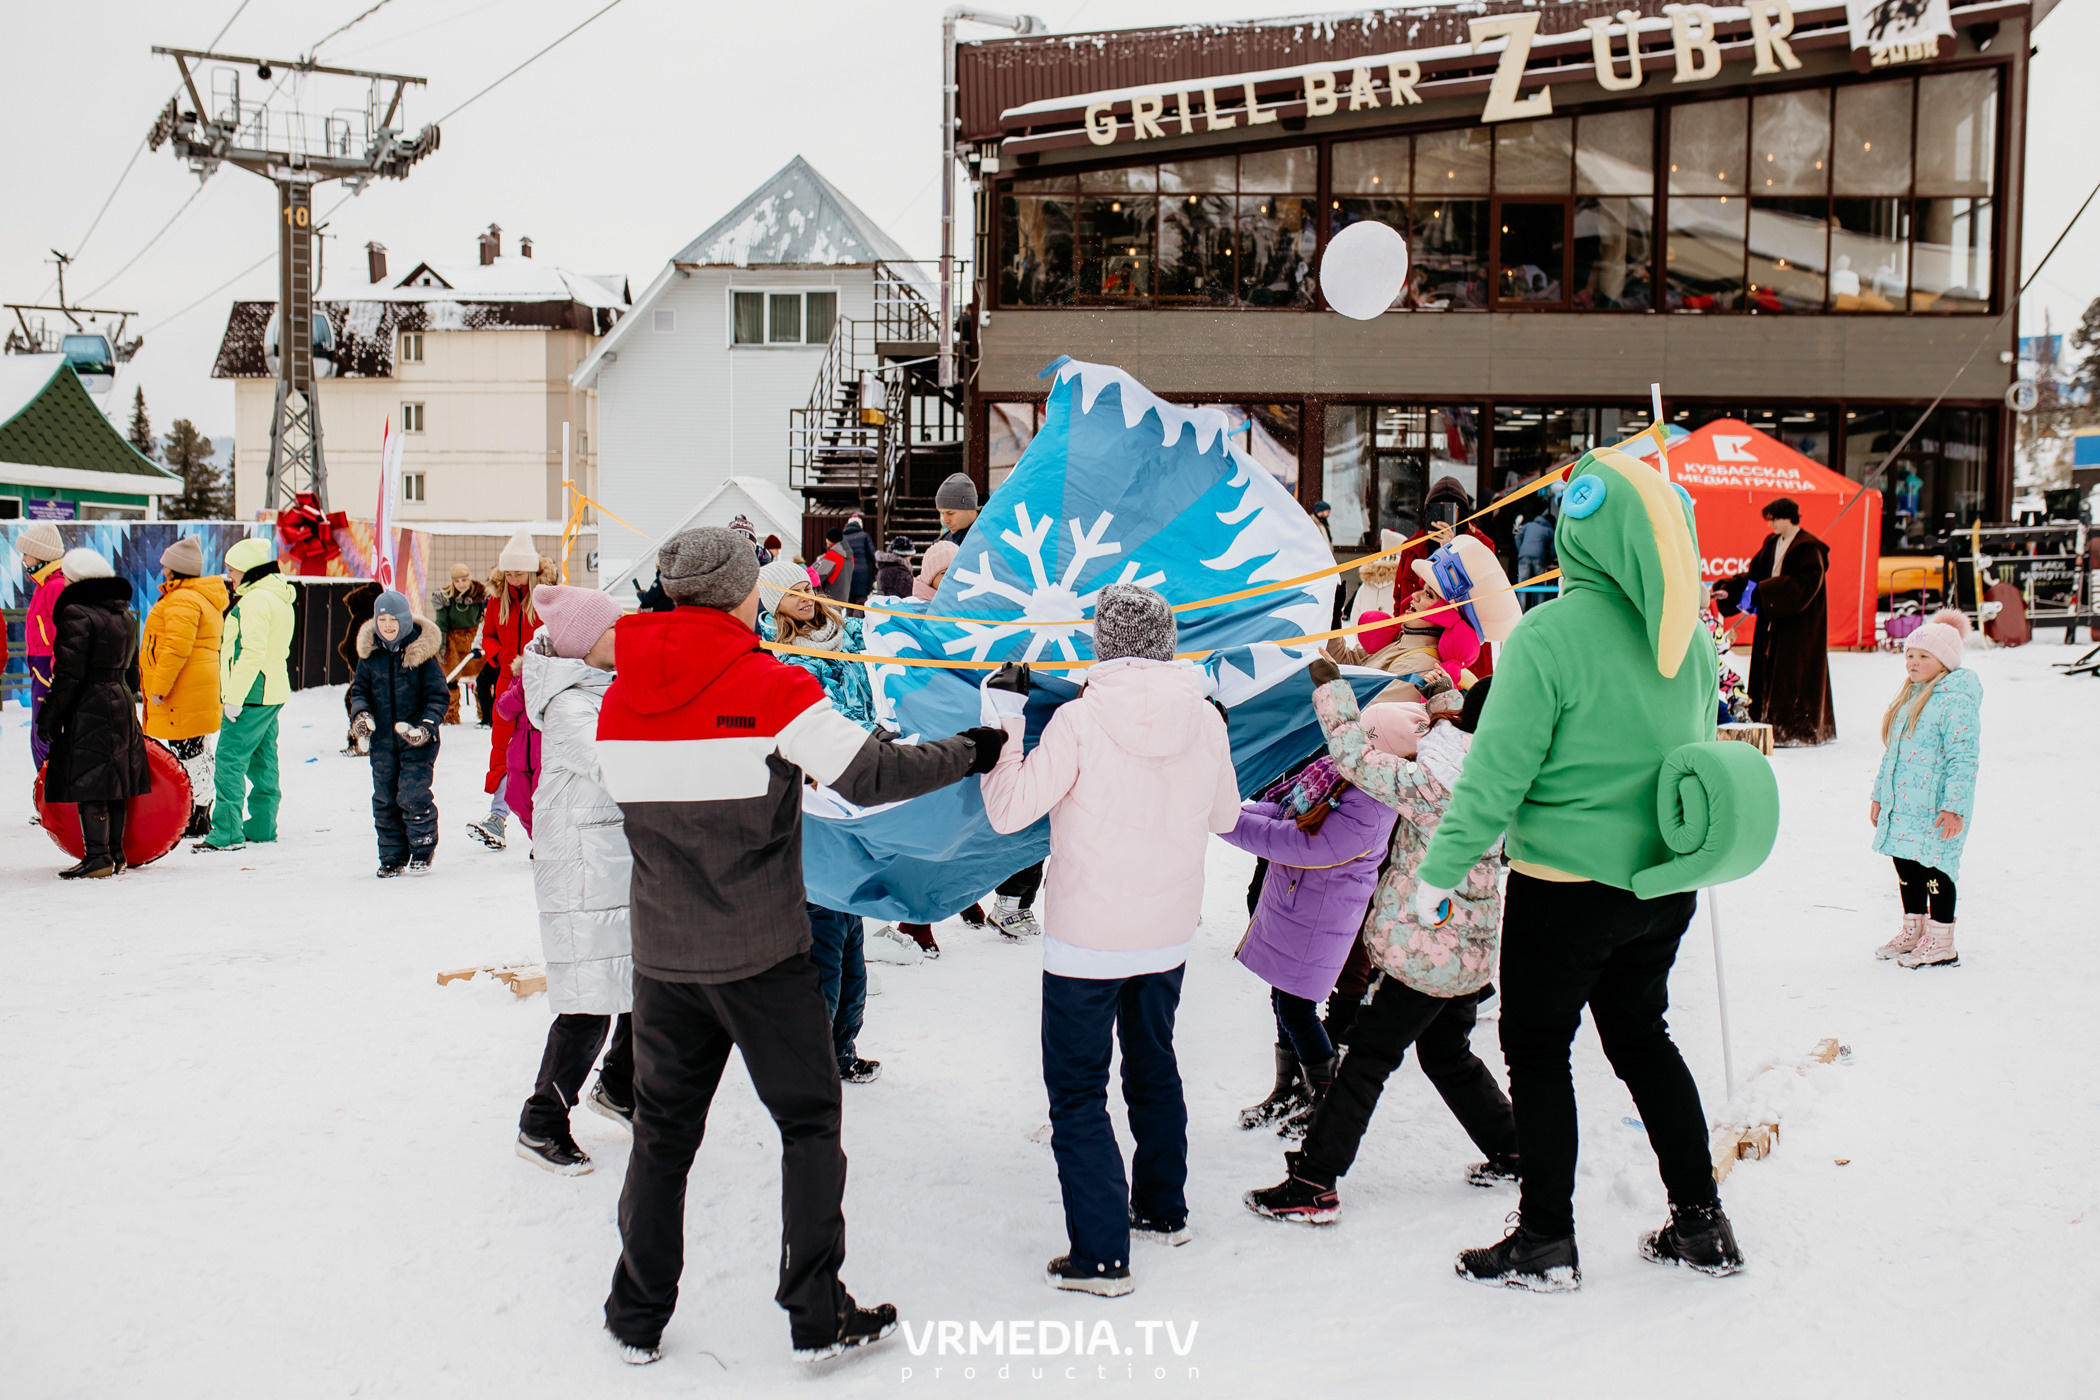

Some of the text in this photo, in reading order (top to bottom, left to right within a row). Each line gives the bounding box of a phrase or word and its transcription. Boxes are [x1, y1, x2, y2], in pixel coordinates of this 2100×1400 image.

[1869, 38, 1939, 67] ZUBR
[1084, 0, 1802, 146] GRILL BAR ZUBR
[283, 205, 309, 227] 10
[1684, 462, 1800, 479] КУЗБАССКАЯ
[1677, 473, 1816, 491] МЕДИА ГРУППА
[716, 715, 756, 729] PUMA
